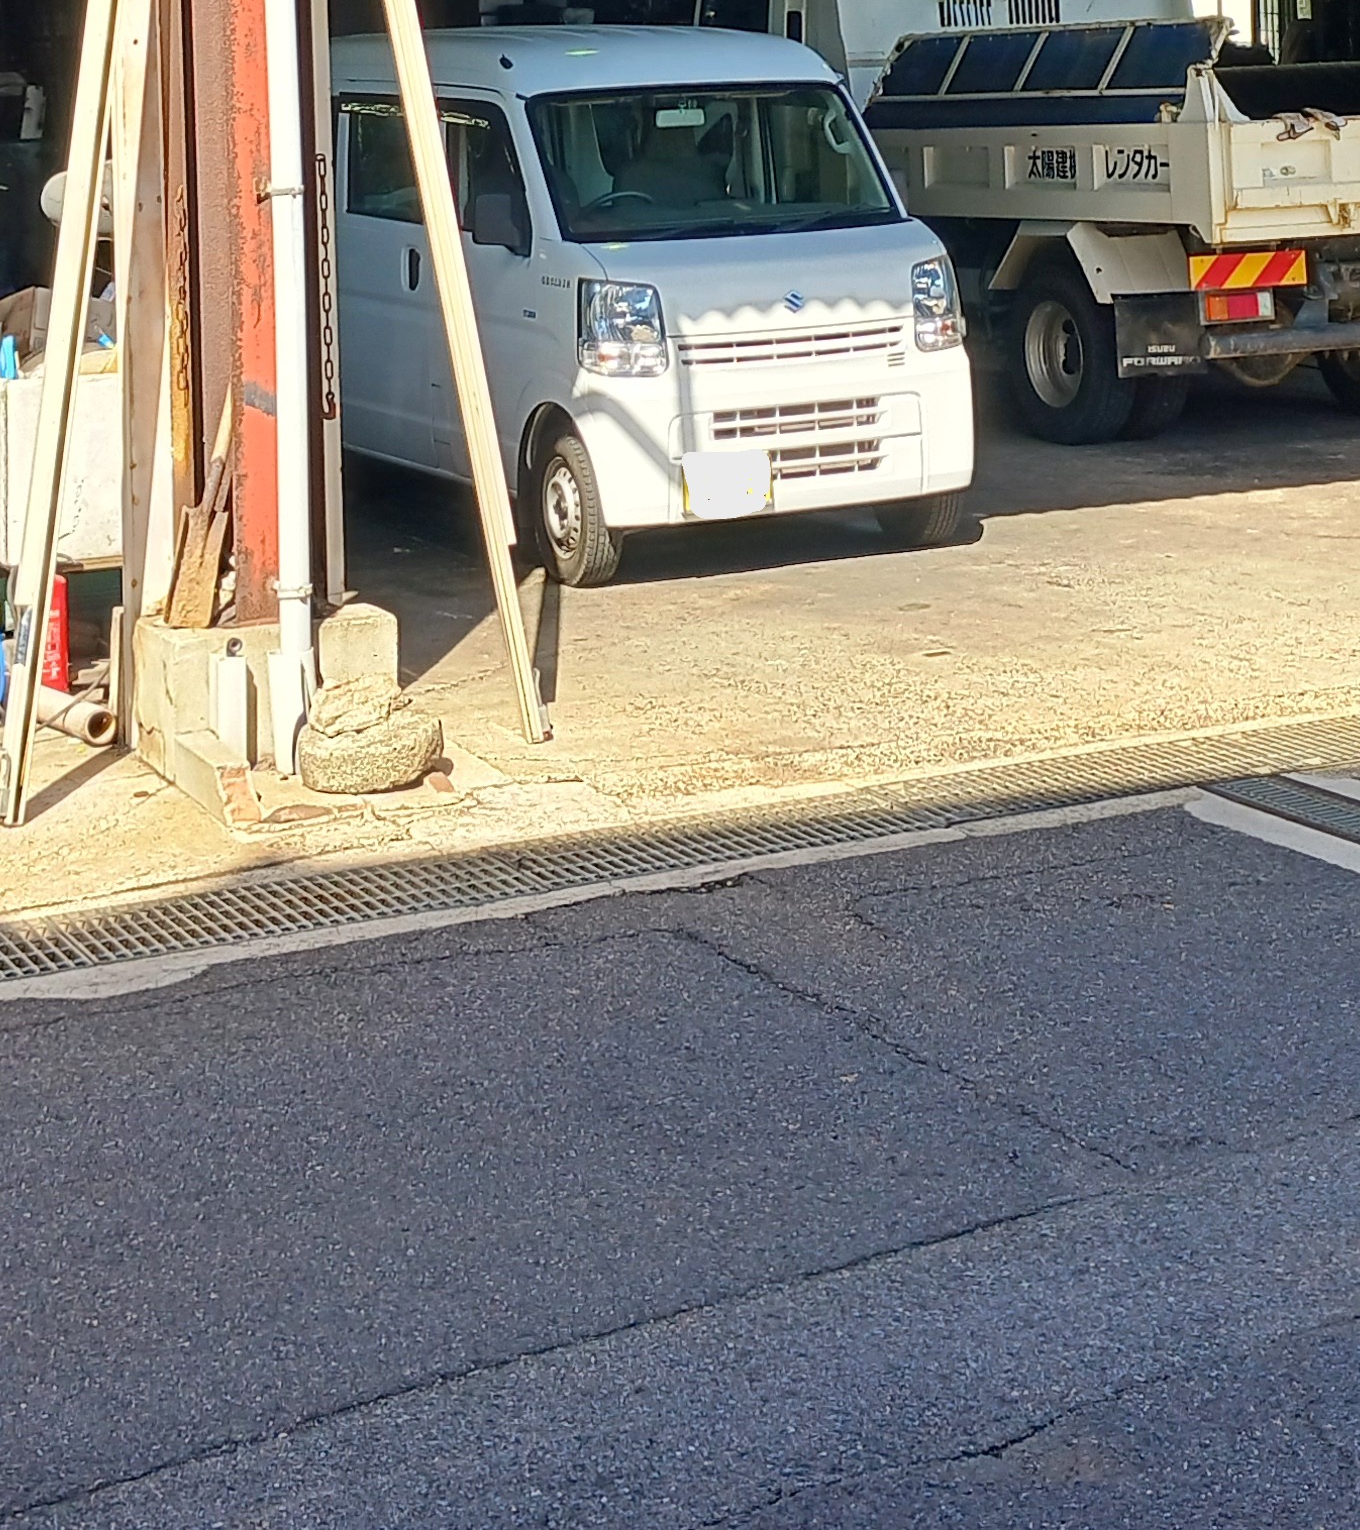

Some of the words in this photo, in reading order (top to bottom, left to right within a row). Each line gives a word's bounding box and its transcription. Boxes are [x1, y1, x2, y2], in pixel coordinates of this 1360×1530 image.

[1105, 149, 1170, 179] レンタカー
